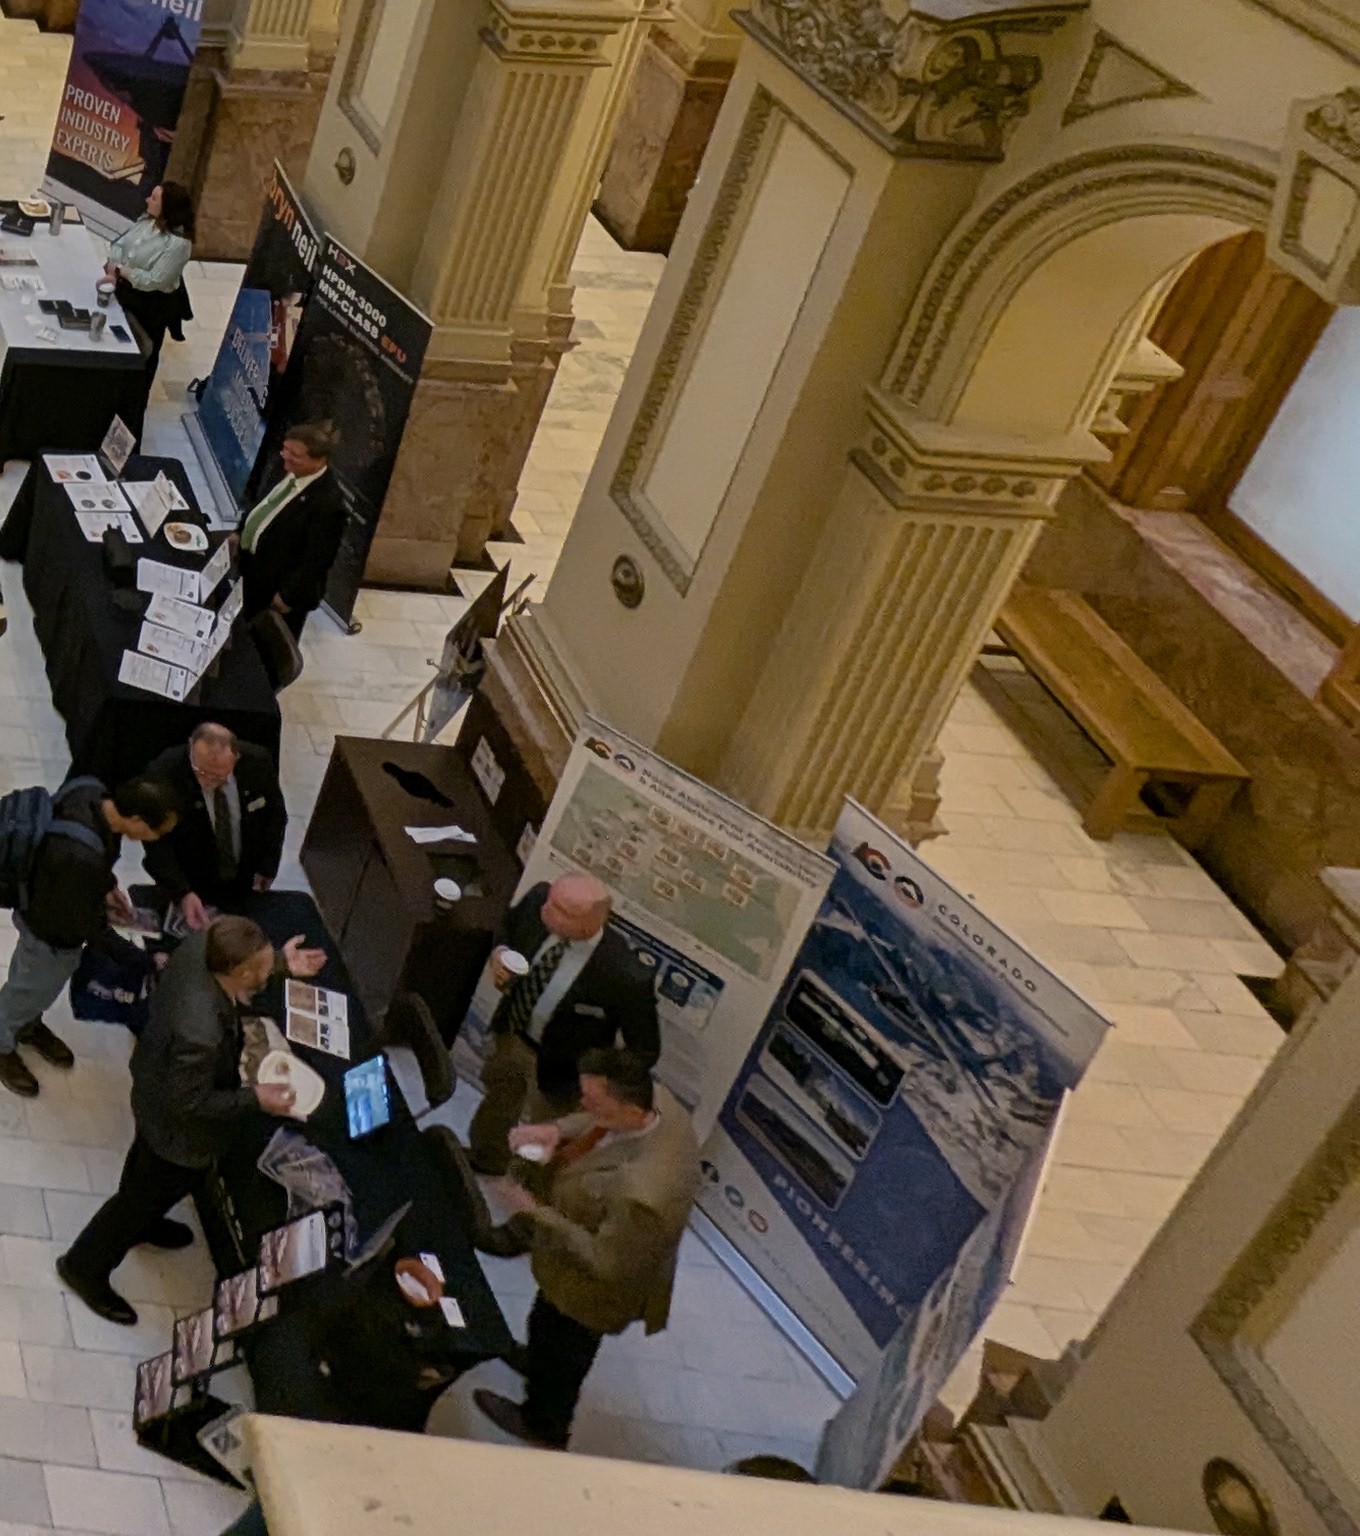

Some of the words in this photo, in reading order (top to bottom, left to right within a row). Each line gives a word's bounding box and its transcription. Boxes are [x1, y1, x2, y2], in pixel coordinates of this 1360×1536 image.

[61, 106, 130, 152] INDUSTRY
[66, 83, 121, 125] PROVEN
[56, 131, 114, 171] EXPERTS
[291, 220, 317, 273] neil
[318, 279, 379, 339] MW-CLASS
[322, 264, 387, 328] HPDM-3000
[938, 903, 1037, 993] COLORADO
